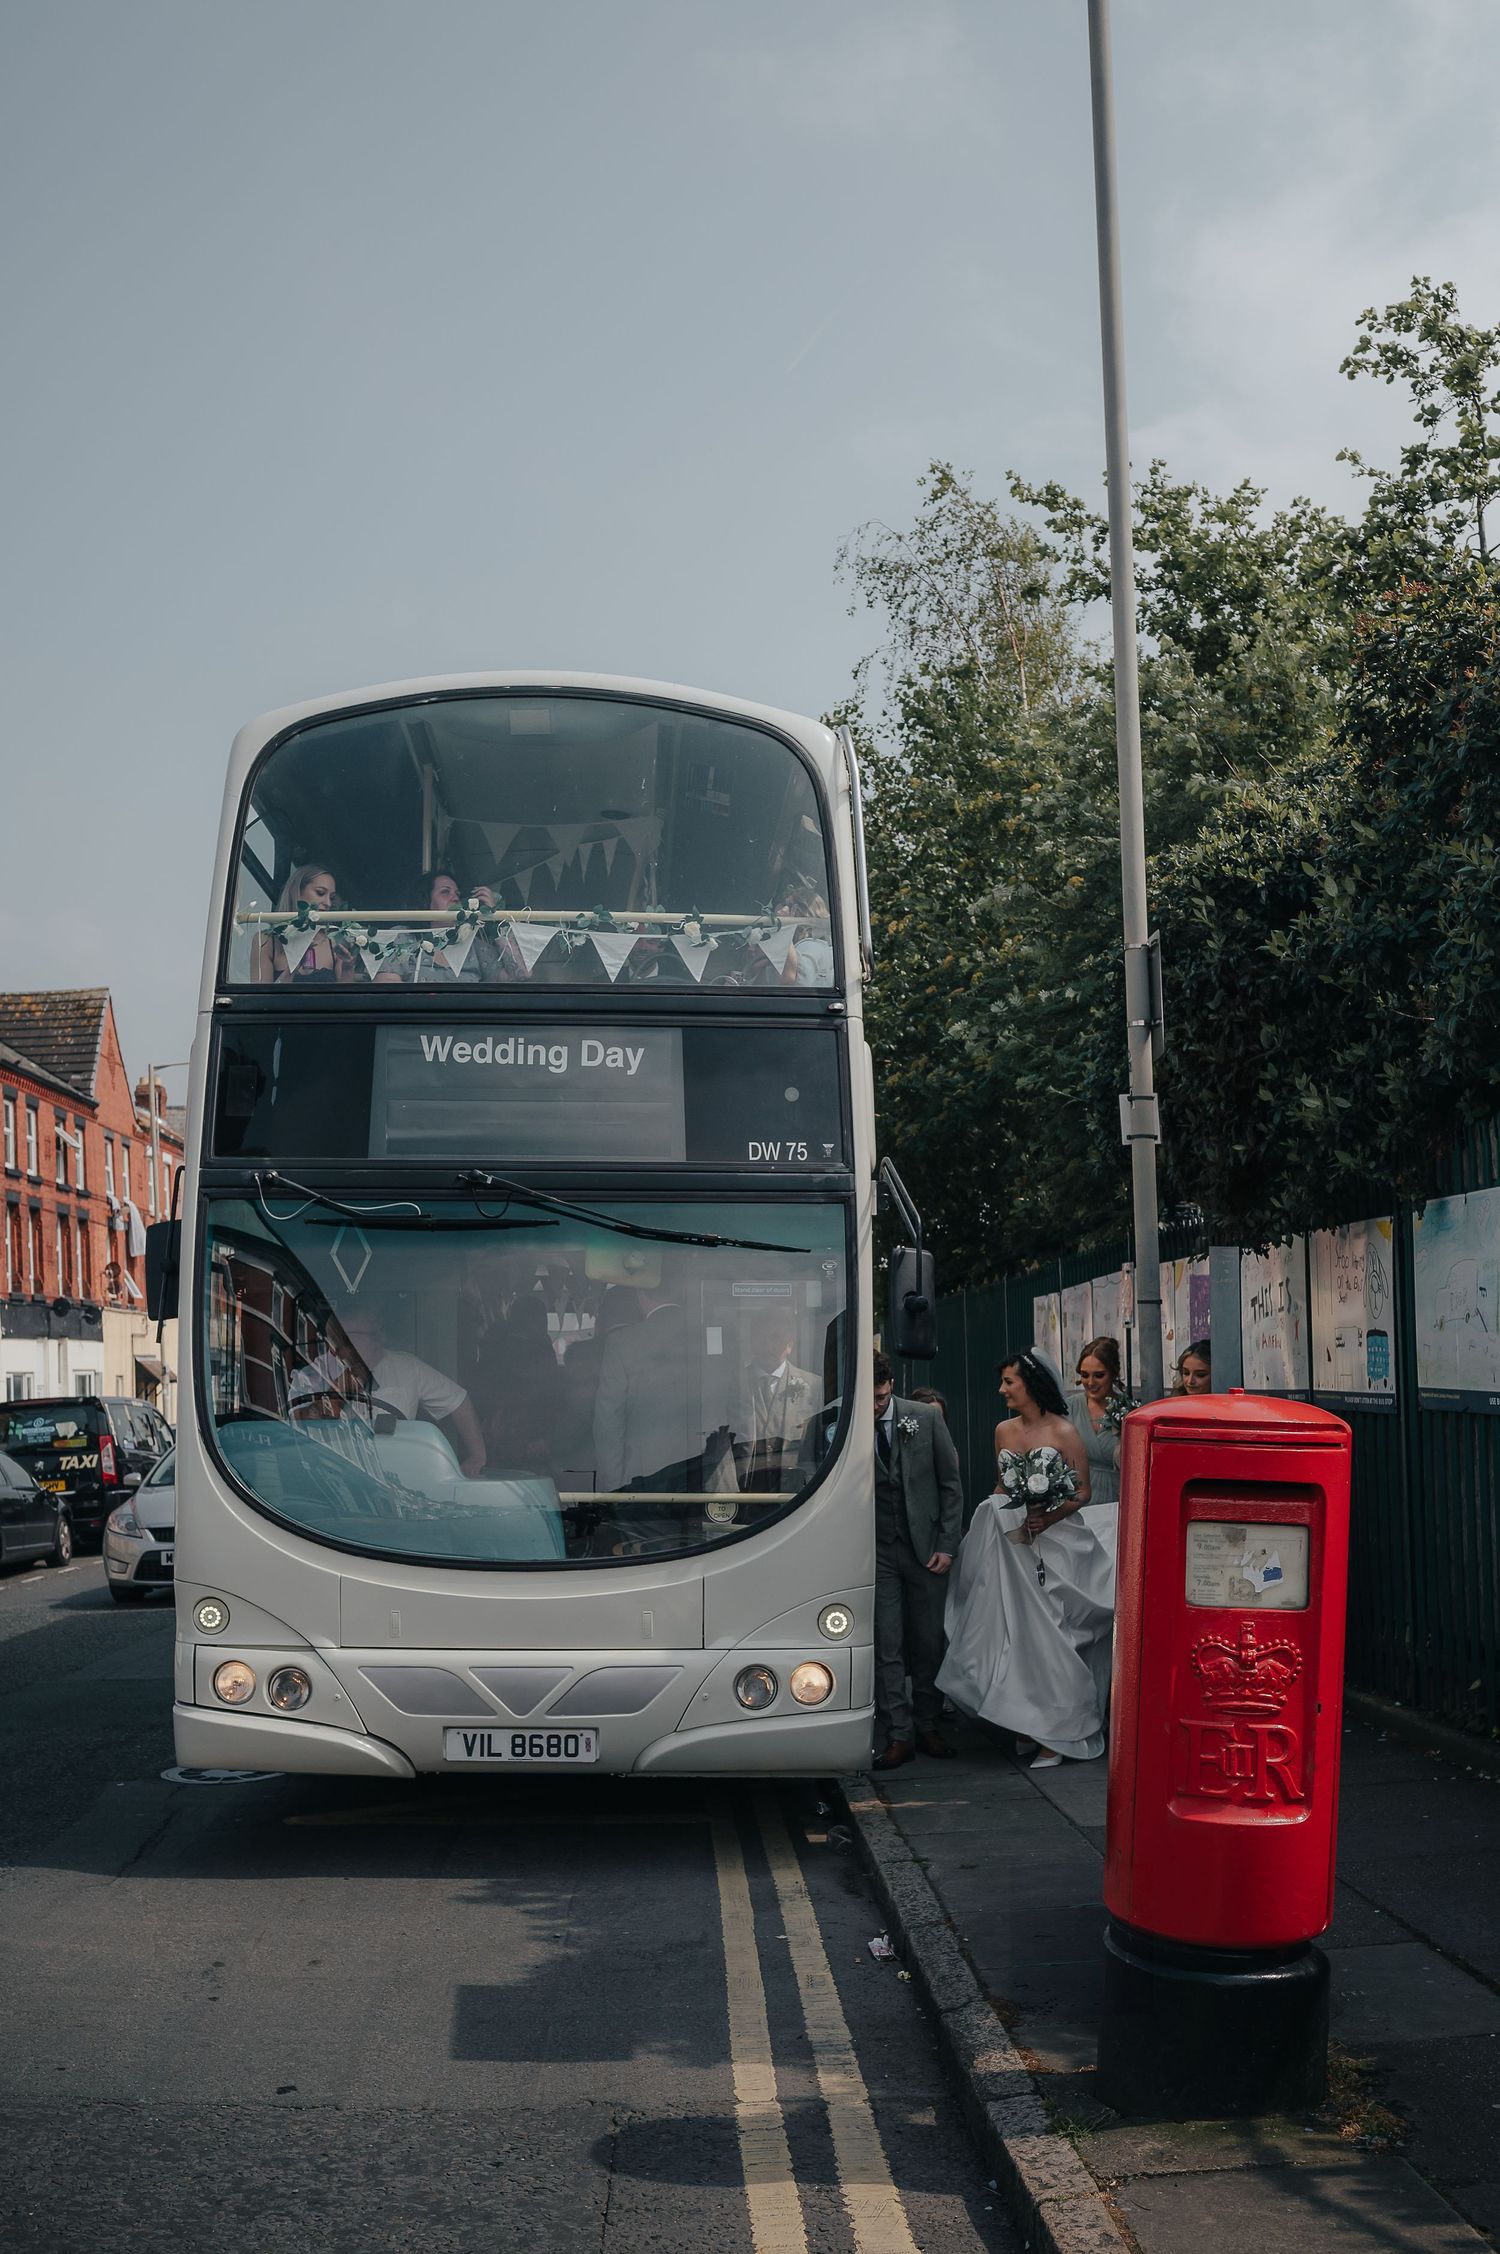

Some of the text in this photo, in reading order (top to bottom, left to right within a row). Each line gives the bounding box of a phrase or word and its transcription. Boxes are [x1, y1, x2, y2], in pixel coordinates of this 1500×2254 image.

[420, 1035, 644, 1076] Wedding Day
[748, 1141, 781, 1161] DW
[786, 1142, 808, 1161] 75
[59, 1454, 99, 1471] TAXI
[462, 1733, 580, 1758] VIL 8680
